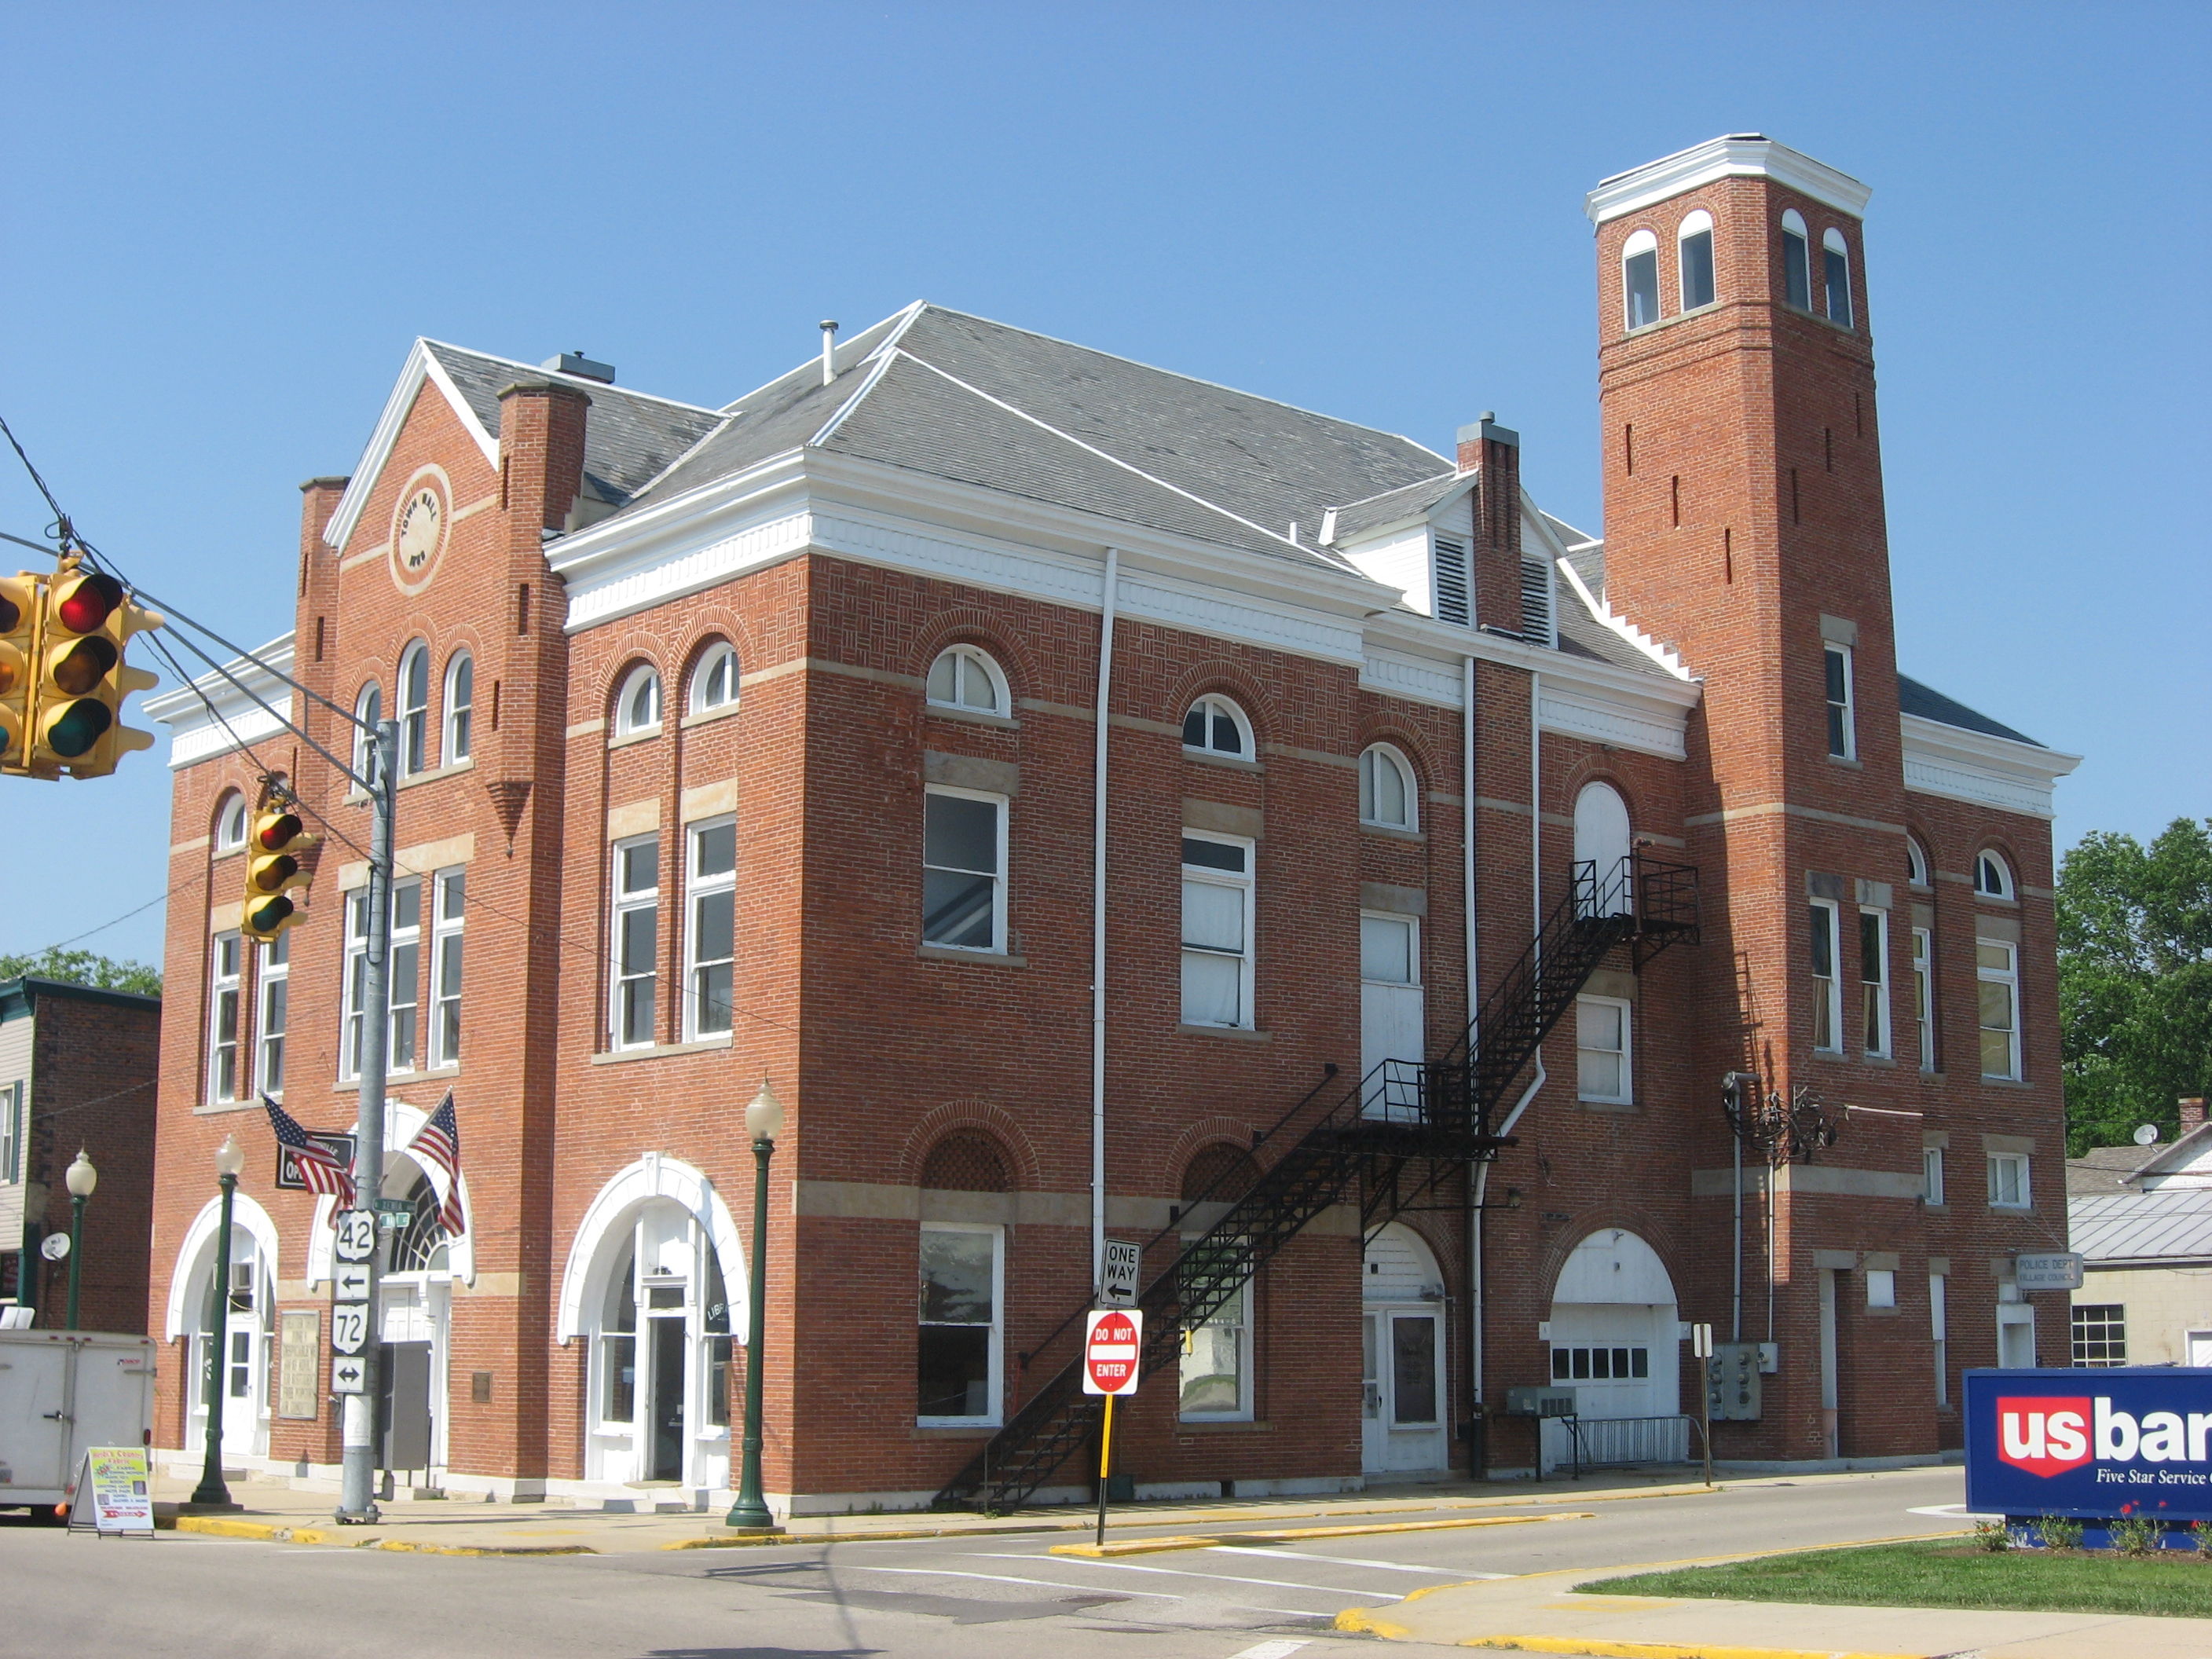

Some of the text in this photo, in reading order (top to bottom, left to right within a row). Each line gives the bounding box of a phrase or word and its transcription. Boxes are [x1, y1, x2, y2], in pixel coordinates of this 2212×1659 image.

[401, 493, 438, 538] TOWN HALL
[339, 1221, 371, 1250] 42
[1109, 1246, 1136, 1264] ONE
[1108, 1264, 1135, 1281] WAY
[2020, 1259, 2073, 1269] POLICE DEPT
[337, 1314, 361, 1342] 72
[1095, 1328, 1132, 1341] DO NOT
[1097, 1364, 1126, 1377] ENTER
[2096, 1468, 2125, 1483] Five
[2128, 1469, 2155, 1484] Star
[2158, 1470, 2207, 1485] Service
